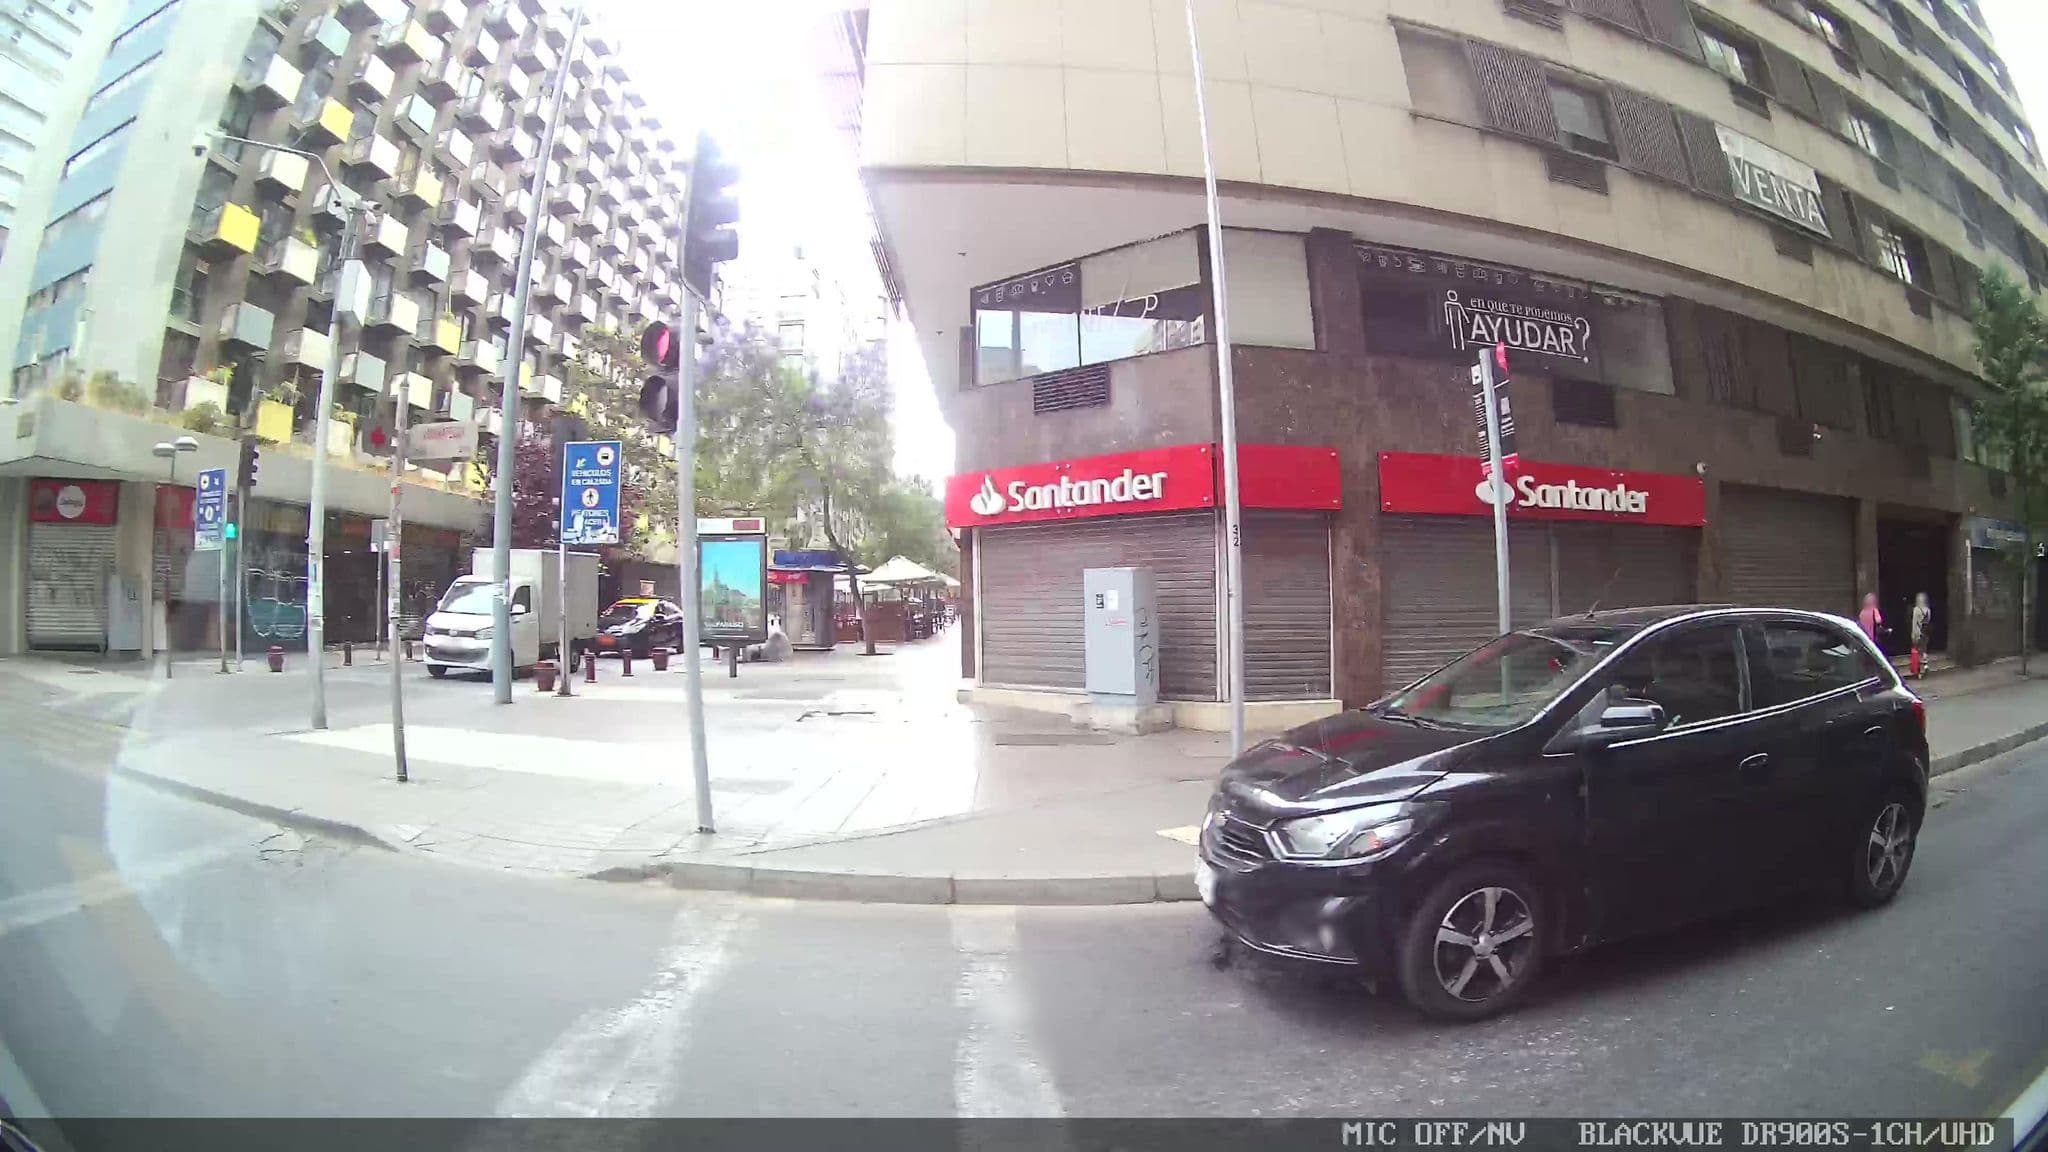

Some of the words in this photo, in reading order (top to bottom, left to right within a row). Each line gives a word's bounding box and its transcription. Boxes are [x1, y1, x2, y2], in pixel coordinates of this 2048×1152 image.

[1730, 156, 1830, 235] VENTA
[1007, 468, 1168, 512] Santander
[1516, 475, 1649, 513] Santander
